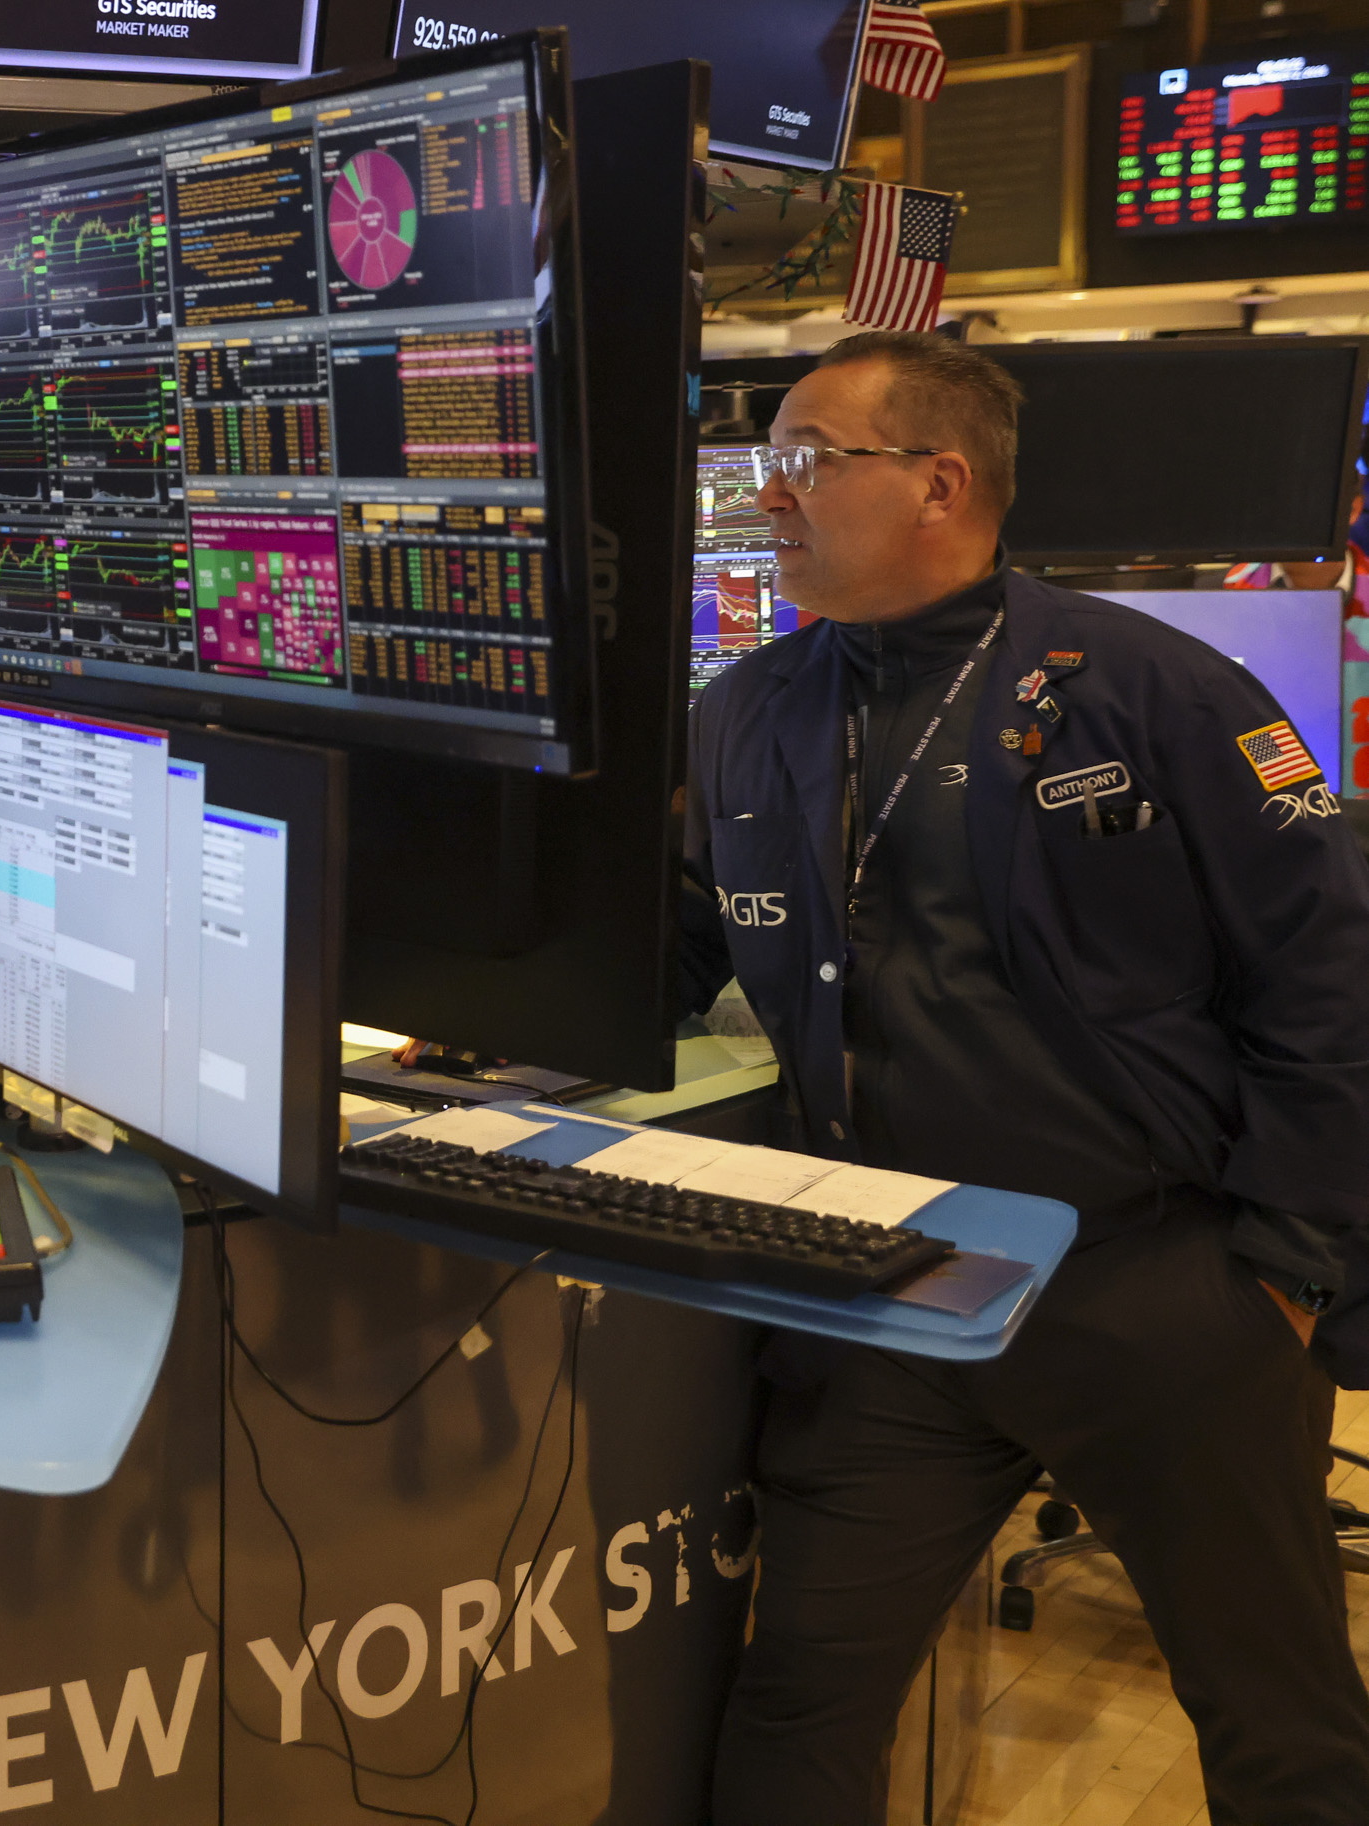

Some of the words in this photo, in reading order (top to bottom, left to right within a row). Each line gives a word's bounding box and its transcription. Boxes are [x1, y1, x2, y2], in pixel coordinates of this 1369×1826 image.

[98, 0, 132, 14] GTS
[135, 0, 216, 19] Securities
[96, 20, 146, 35] MARKET
[147, 23, 189, 38] MAKER
[977, 626, 997, 650] STATE
[956, 660, 976, 683] PENN
[943, 681, 963, 705] STATE
[925, 716, 942, 739] PENN
[910, 736, 929, 762] STATE
[894, 773, 909, 797] PENN
[1048, 770, 1119, 801] ANTHONY
[878, 794, 897, 821] STATE
[859, 833, 879, 857] PENN
[731, 892, 787, 927] GTS
[245, 1545, 579, 1746] YORK
